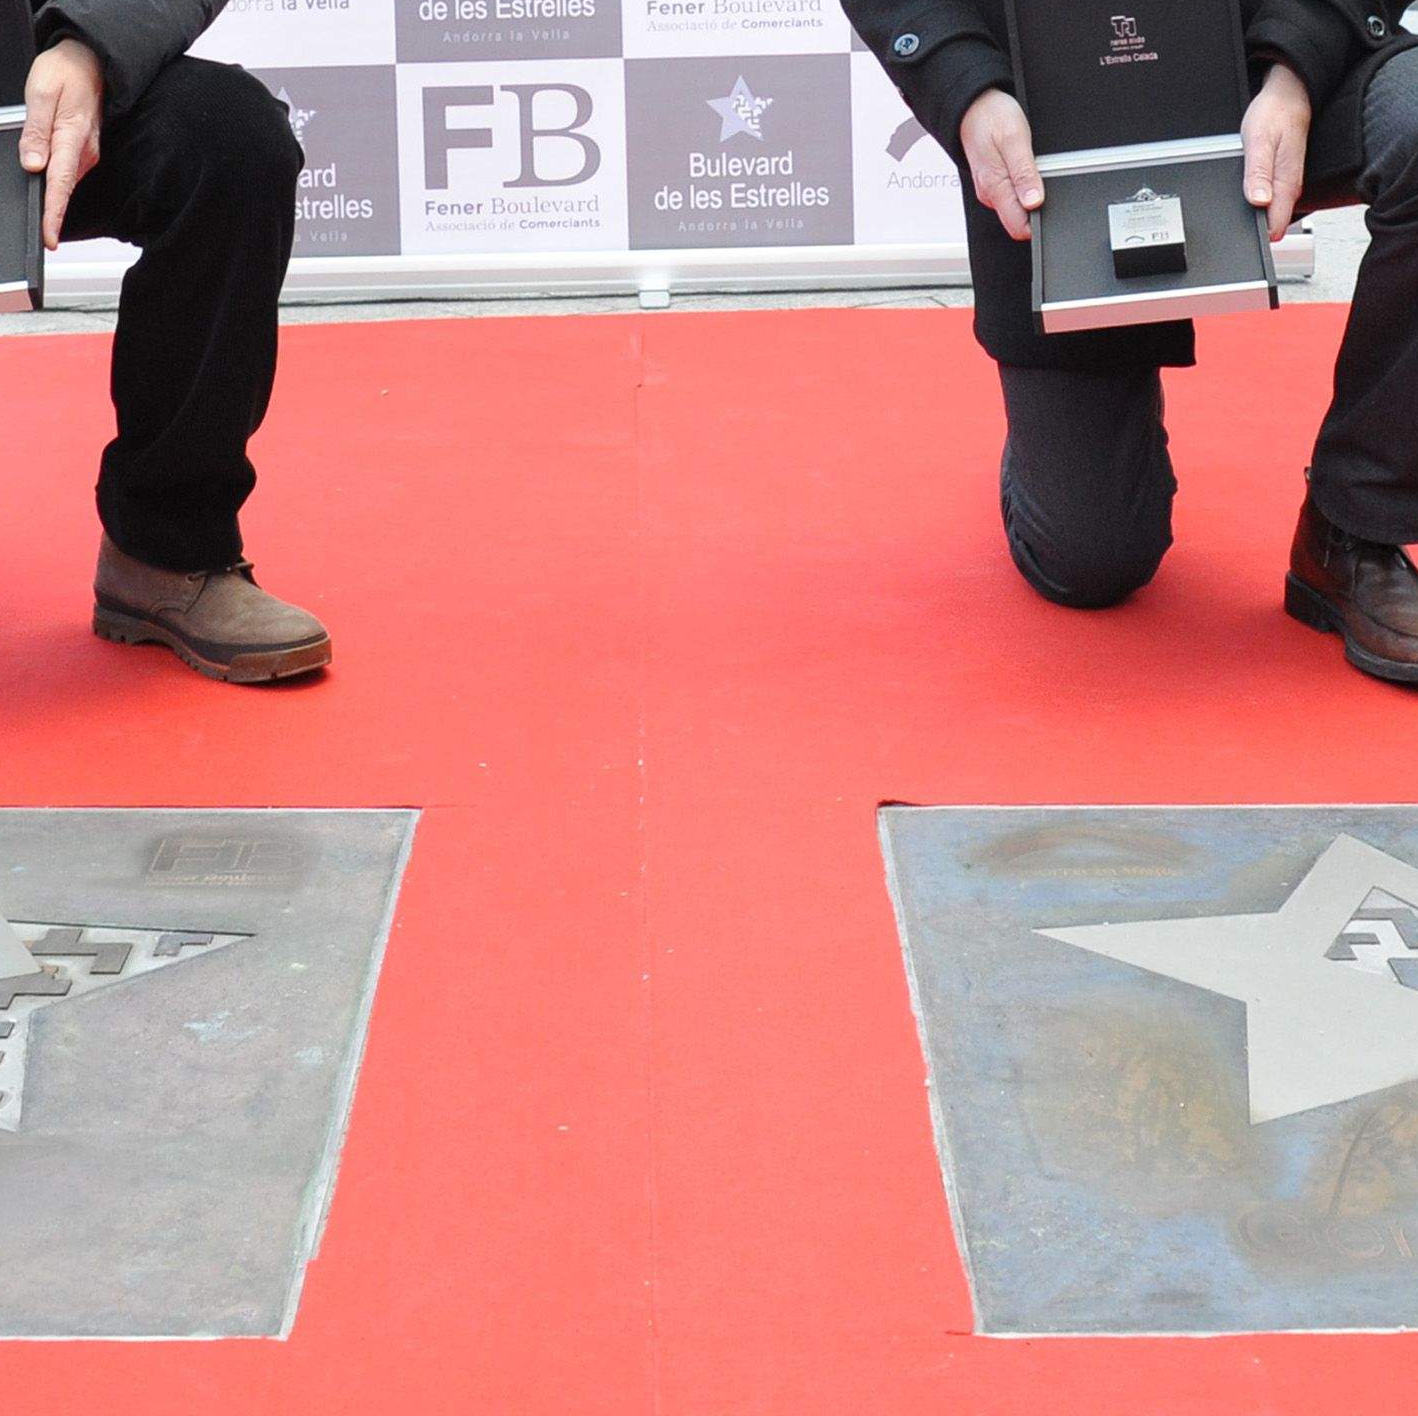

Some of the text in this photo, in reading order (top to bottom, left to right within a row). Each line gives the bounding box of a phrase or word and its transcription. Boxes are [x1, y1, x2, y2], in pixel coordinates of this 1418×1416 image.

[647, 0, 705, 16] Fener
[741, 18, 822, 30] Comerciants
[421, 83, 601, 191] FB
[689, 150, 793, 177] Bulevard
[294, 194, 373, 220] strelles
[425, 195, 599, 216] Fener Boulevard
[655, 181, 829, 210] de les Estrelles
[519, 218, 600, 229] Comerciants
